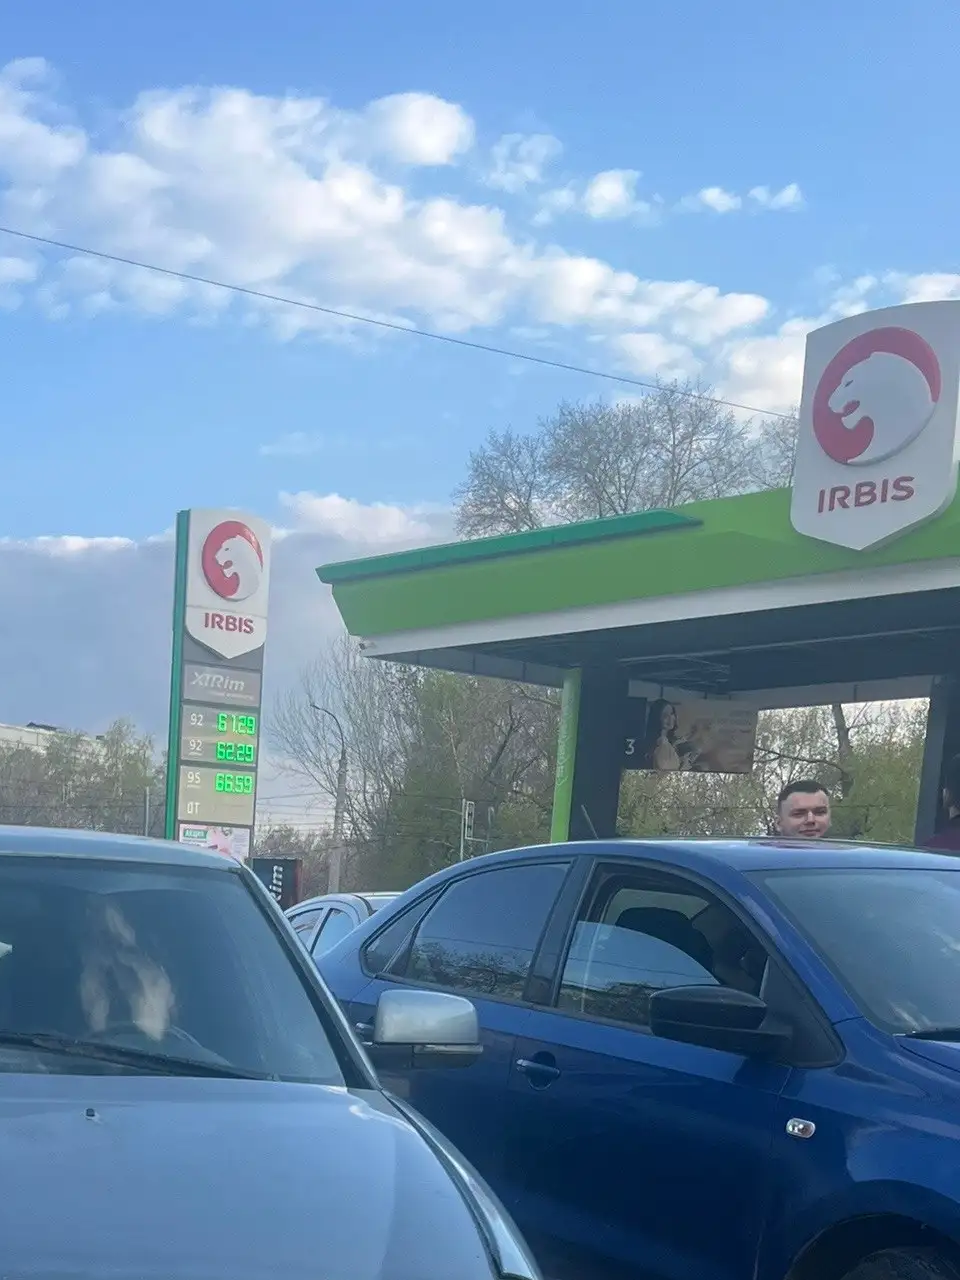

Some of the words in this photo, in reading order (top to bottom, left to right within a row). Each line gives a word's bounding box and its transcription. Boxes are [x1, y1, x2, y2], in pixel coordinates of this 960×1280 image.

[817, 476, 915, 513] IRBIS
[204, 612, 254, 634] IRBIS
[190, 713, 203, 726] 92
[217, 713, 255, 735] 61.29
[189, 739, 202, 751] 92
[217, 742, 254, 762] 62.29
[625, 738, 636, 755] 3
[187, 771, 201, 784] 95
[215, 773, 253, 794] 66.59
